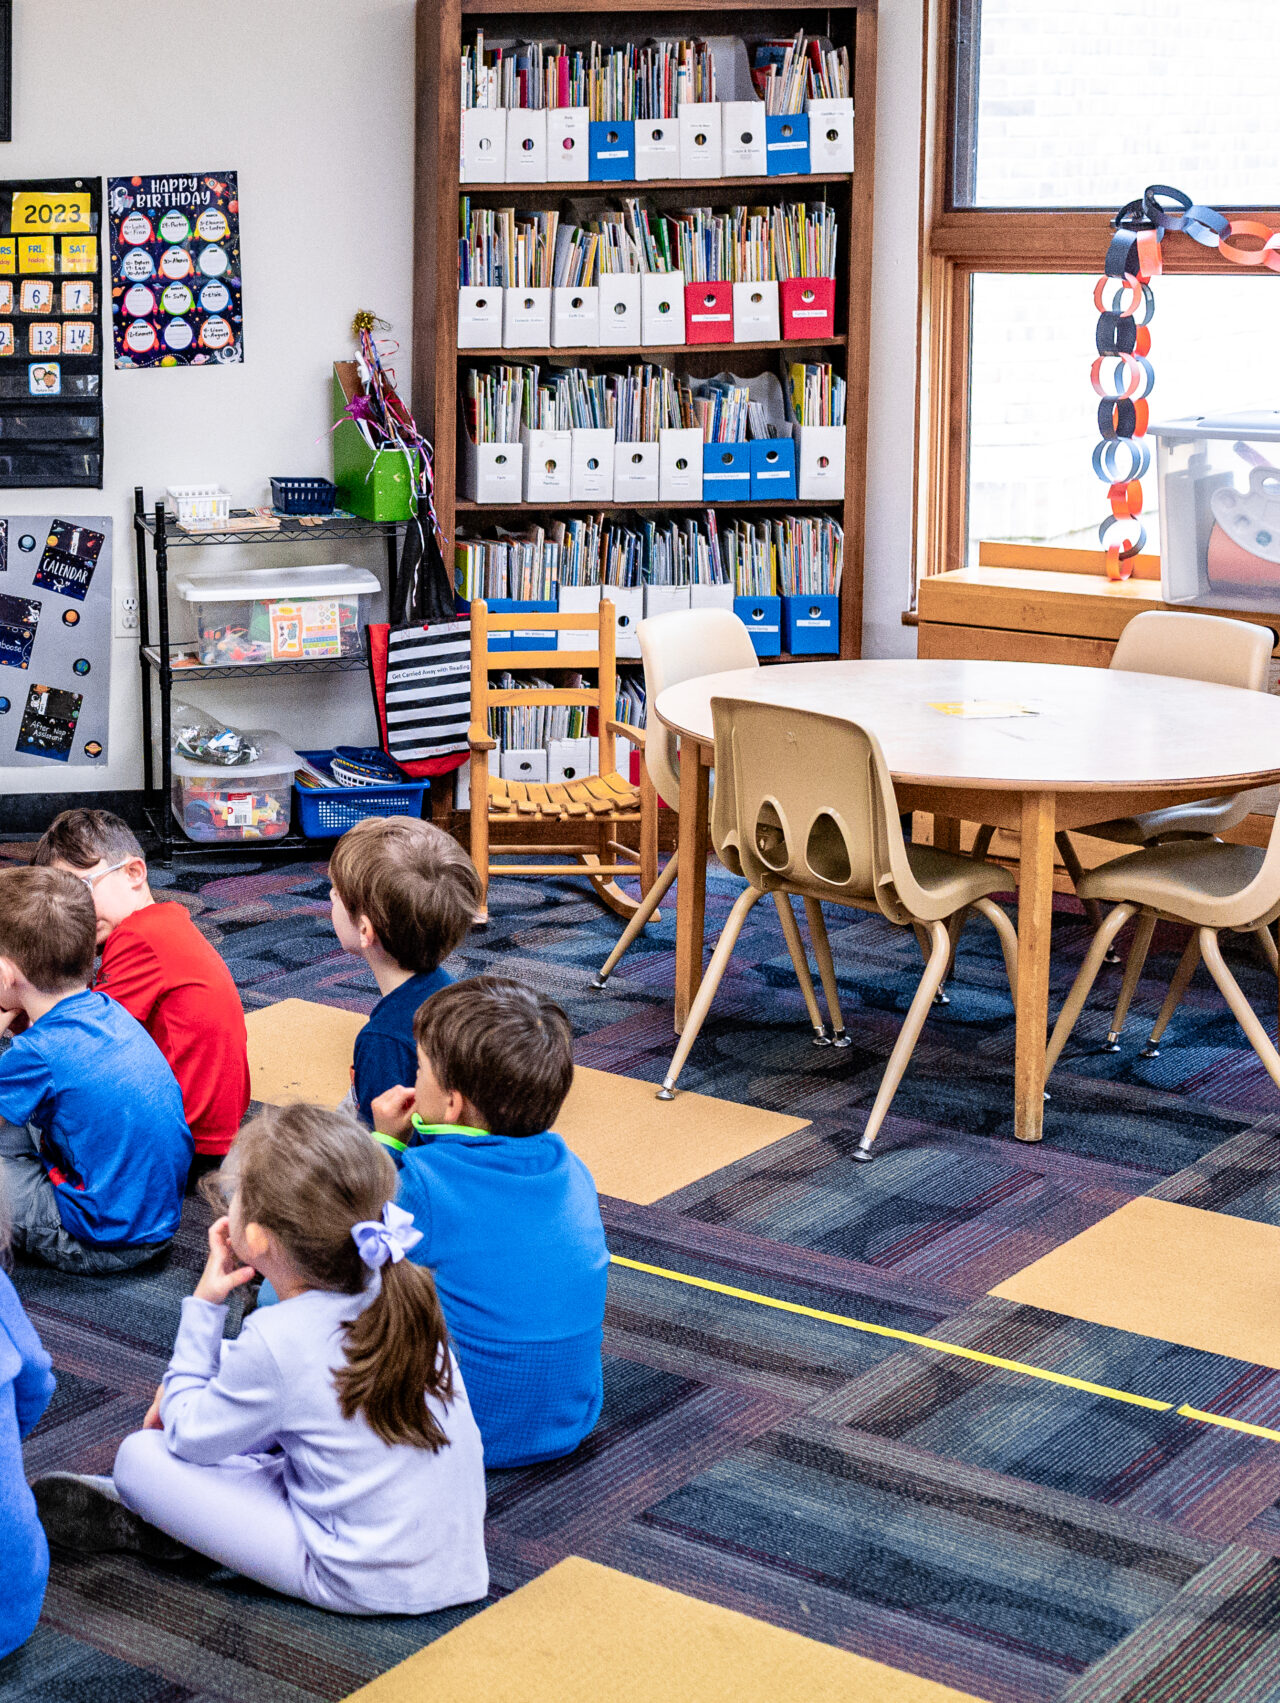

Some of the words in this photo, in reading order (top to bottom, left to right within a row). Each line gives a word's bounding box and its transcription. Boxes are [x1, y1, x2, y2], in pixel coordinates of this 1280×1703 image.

[151, 177, 198, 193] HAPPY
[136, 191, 210, 208] BIRTHDAY
[24, 204, 81, 223] 2023
[28, 245, 44, 253] FRI.
[32, 289, 41, 304] 6
[74, 289, 81, 305] 7
[37, 331, 53, 345] 13
[70, 329, 85, 344] 14
[43, 558, 88, 583] CALENDAR
[30, 721, 50, 731] After
[53, 727, 66, 736] Nap
[32, 730, 63, 741] Assistant
